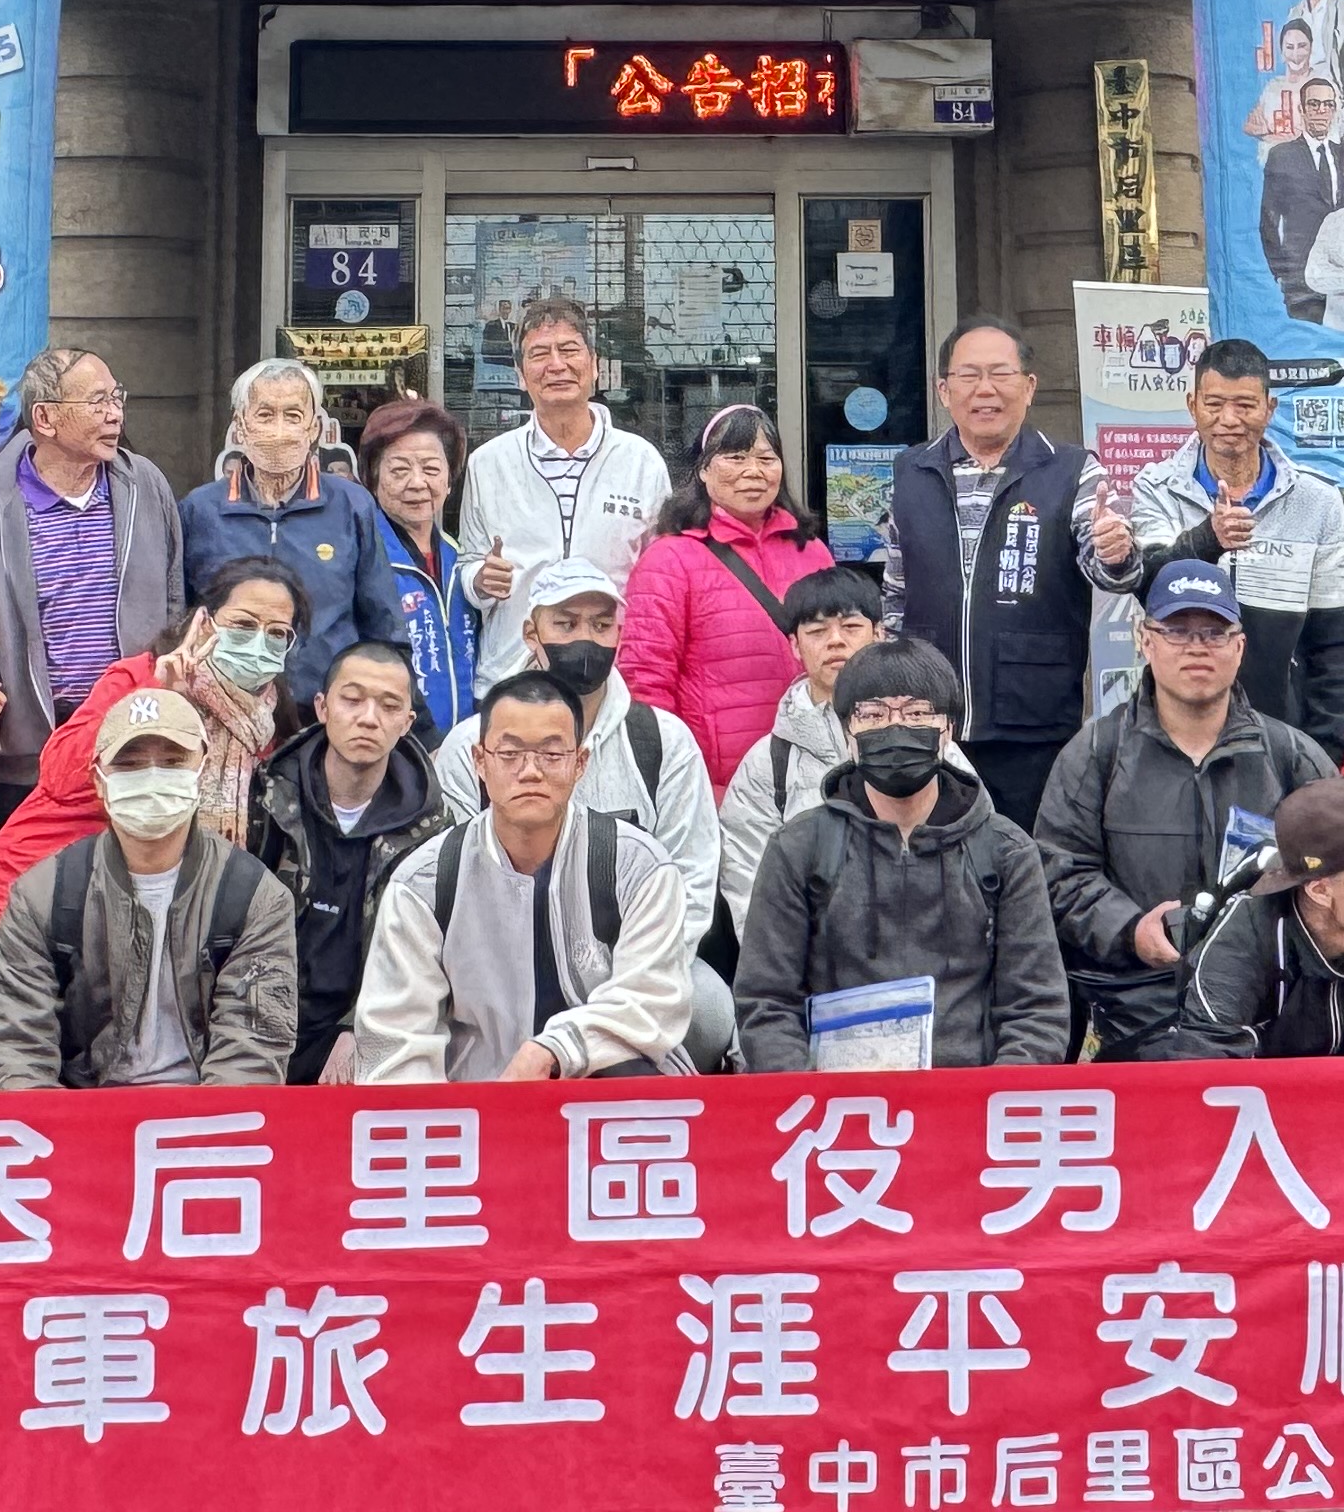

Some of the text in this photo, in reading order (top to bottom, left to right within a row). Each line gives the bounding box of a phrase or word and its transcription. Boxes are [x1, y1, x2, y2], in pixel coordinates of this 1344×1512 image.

[952, 102, 975, 121] 84
[331, 251, 377, 286] 84
[130, 696, 159, 724] NY
